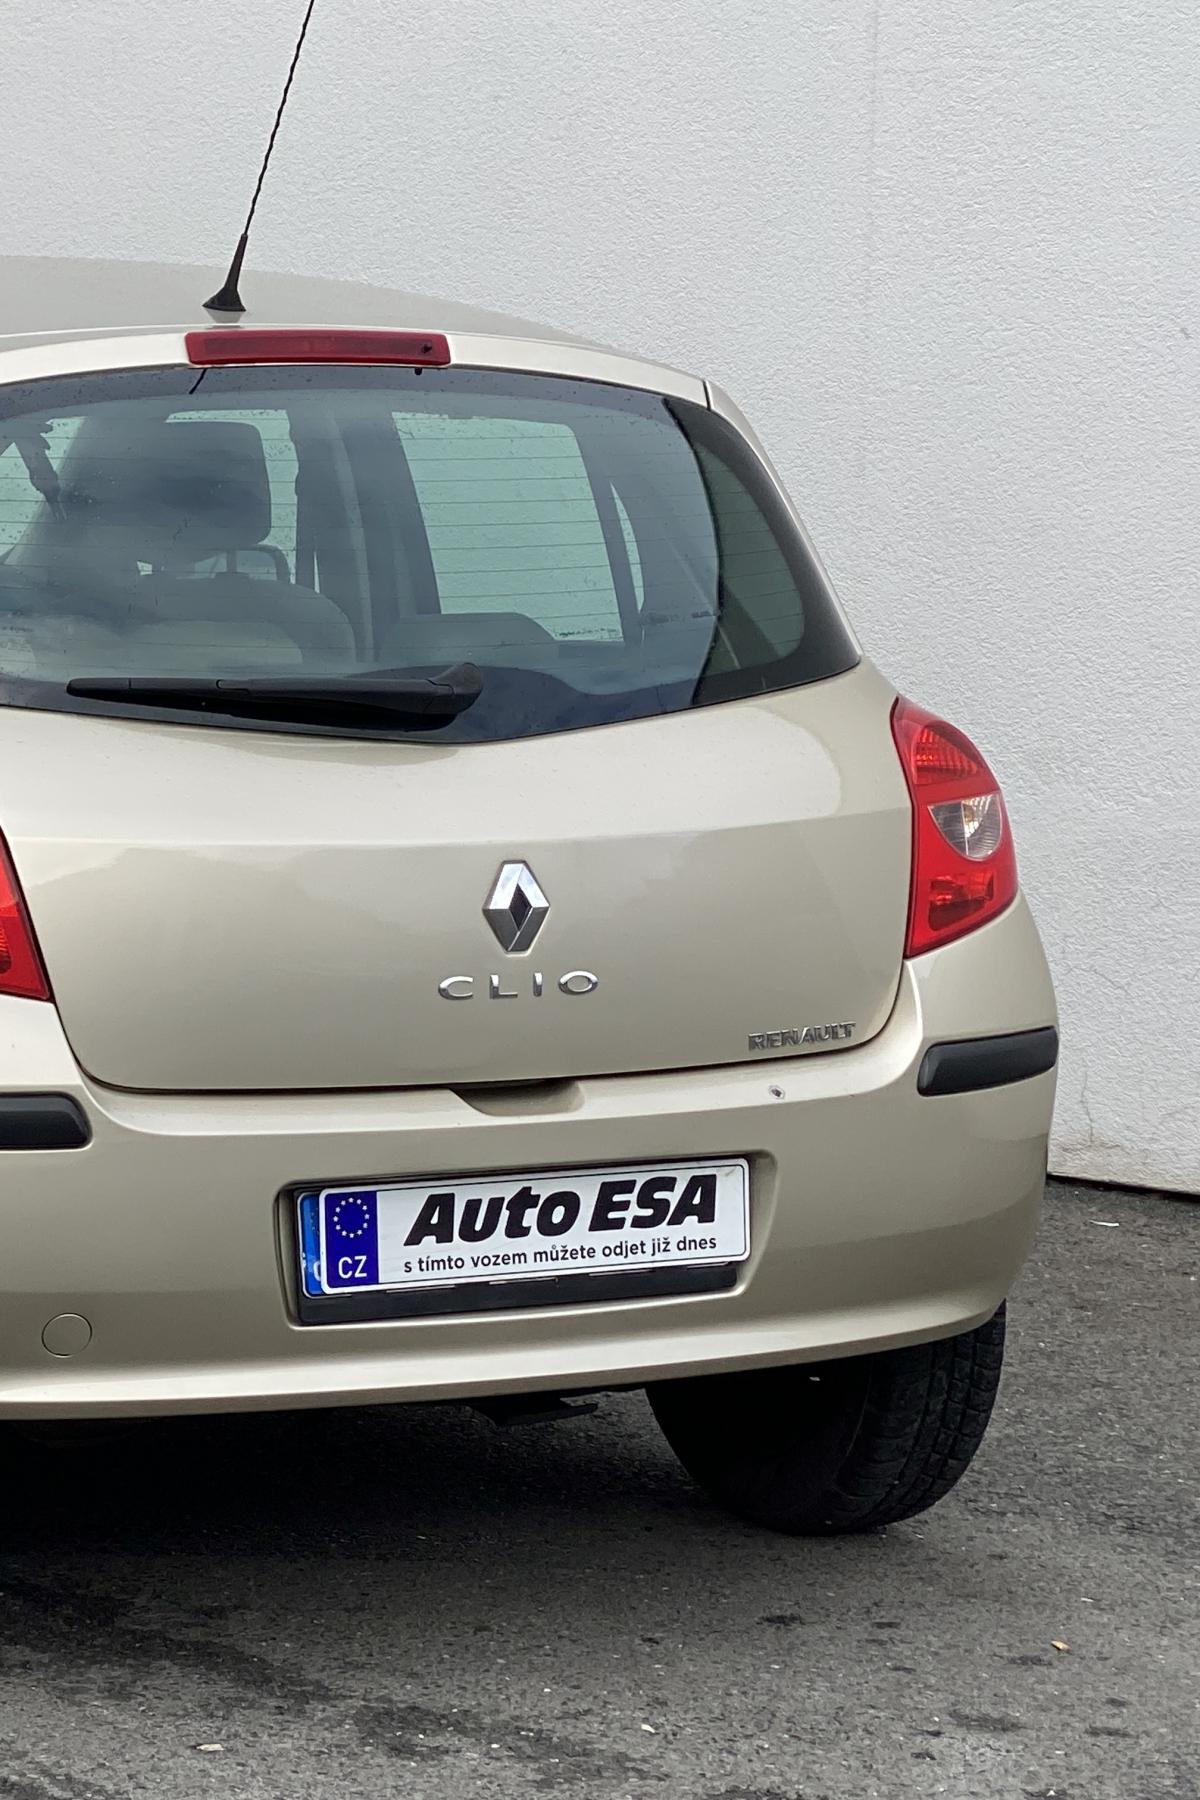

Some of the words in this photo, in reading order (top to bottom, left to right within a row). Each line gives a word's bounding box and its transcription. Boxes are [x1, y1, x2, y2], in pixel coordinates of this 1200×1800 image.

[438, 970, 599, 1001] CLIO
[748, 1021, 856, 1051] RENAULT
[403, 1186, 581, 1247] Auto
[588, 1173, 717, 1232] ESA
[338, 1255, 368, 1279] CZ
[404, 1261, 412, 1273] s
[418, 1255, 465, 1272] tímto
[470, 1252, 527, 1268] vozem
[533, 1245, 596, 1263] můžete
[602, 1240, 646, 1259] odjet
[651, 1237, 671, 1257] již
[676, 1236, 717, 1251] dnes
